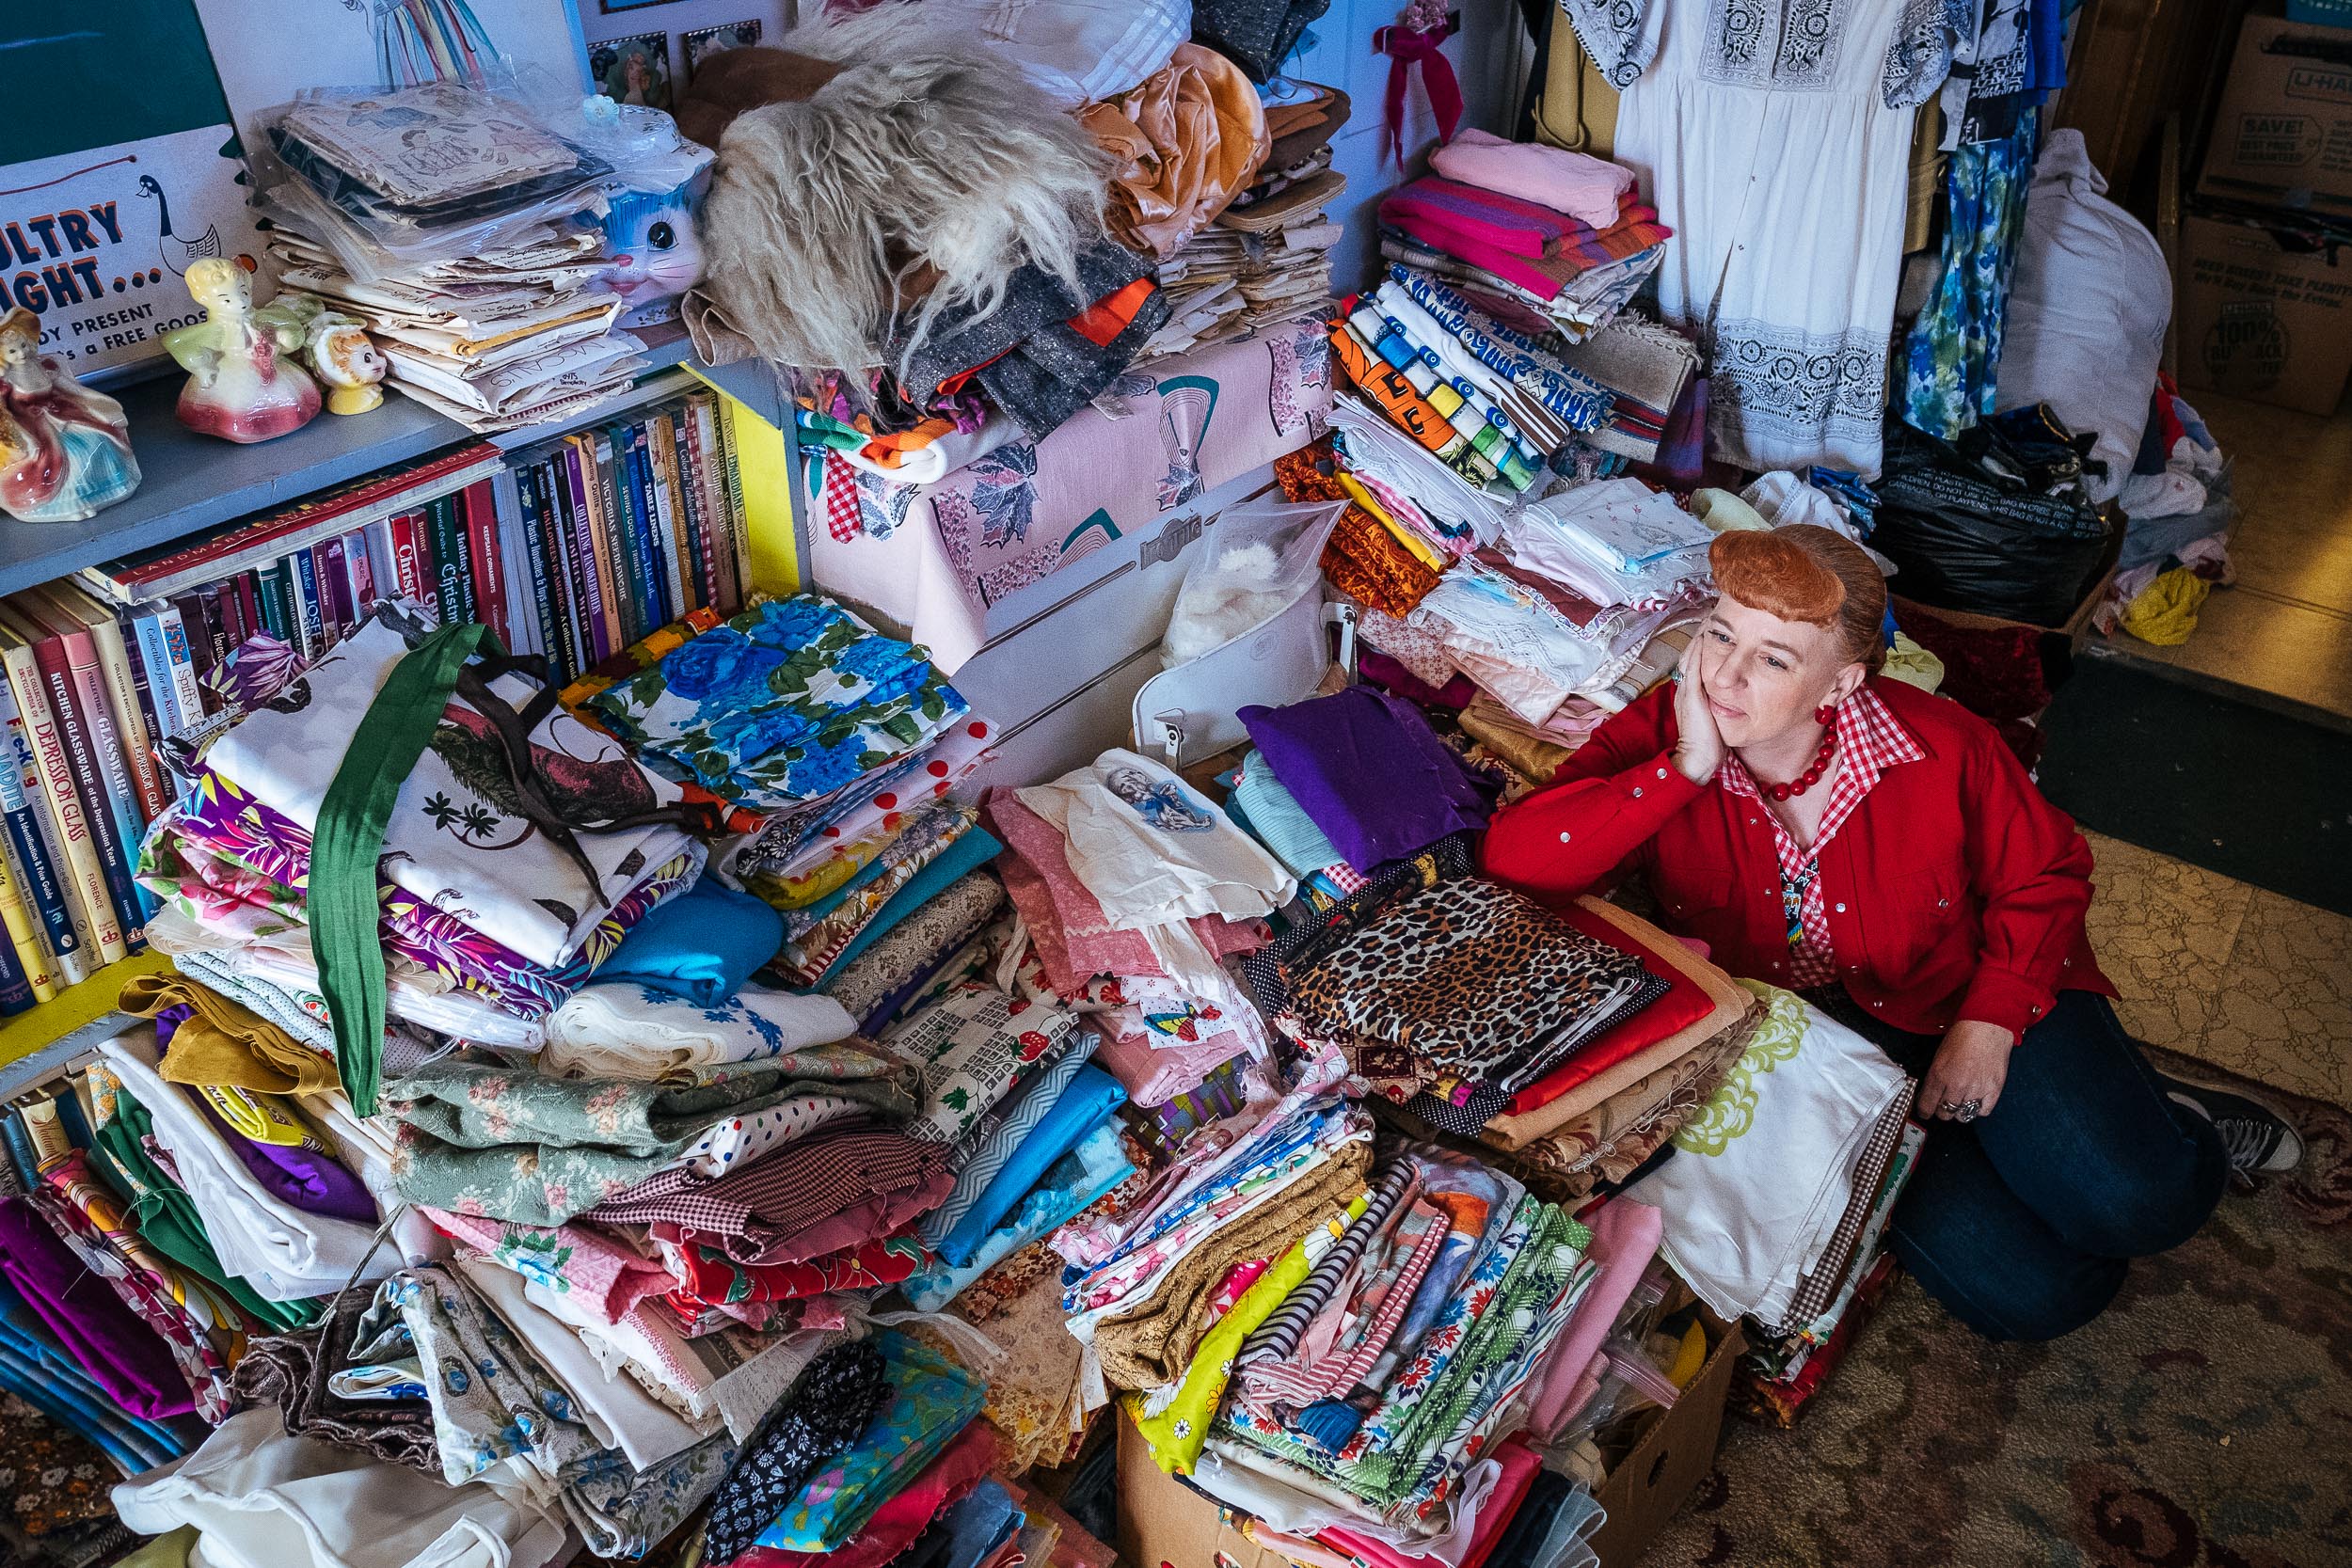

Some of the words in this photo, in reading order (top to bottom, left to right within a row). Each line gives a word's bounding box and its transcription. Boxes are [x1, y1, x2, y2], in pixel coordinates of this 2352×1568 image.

[2294, 73, 2352, 94] U-HA
[2247, 119, 2303, 134] SAVE!
[71, 301, 154, 342] PRESENT
[496, 302, 528, 316] Simplicity
[86, 342, 99, 356] a
[103, 325, 148, 356] FREE
[723, 427, 735, 449] World
[583, 452, 596, 481] ollecting
[640, 450, 650, 481] ELEGANT
[666, 449, 678, 477] Vintage
[676, 448, 691, 481] Colorful
[534, 472, 548, 499] Schneider
[589, 483, 602, 511] Quilts,
[644, 482, 655, 513] TABLE
[671, 478, 683, 508] Souvenir
[703, 456, 723, 496] Antique
[714, 500, 727, 533] Linens
[725, 454, 745, 510] EDWARDIANA
[134, 532, 250, 577] LANDMARK
[262, 496, 344, 531] TOURIST
[357, 448, 480, 499] ATTRACTIONS
[434, 500, 446, 530] Pictorial
[621, 484, 632, 514] SEWING
[657, 485, 671, 519] More
[683, 482, 698, 526] Tablecloths
[415, 520, 430, 552] Brenner
[437, 530, 446, 550] Guide
[480, 525, 493, 557] KEEPSAKE
[524, 518, 540, 545] Plastic
[540, 509, 559, 562] HALLOWEEN
[573, 502, 593, 550] COLLECTING
[594, 512, 606, 550] Investments
[599, 477, 617, 532] VICTORIAN
[608, 534, 628, 601] NEEDLEWORK
[626, 514, 636, 538] TOOLS
[647, 513, 660, 546] LINENS
[675, 510, 688, 546] Tablecloths
[315, 553, 325, 573] Harris
[453, 531, 470, 573] Holiday
[528, 545, 546, 578] Novelties
[566, 531, 582, 583] Fashions
[630, 548, 641, 579] TRINKETS
[297, 557, 315, 590] Whitaker
[484, 557, 498, 594] ORNAMENTS
[580, 552, 603, 615] HANDKERCHIEFS
[600, 558, 612, 588] America's
[319, 578, 330, 606] Whitaker
[460, 574, 475, 609] Plastic
[534, 584, 548, 602] Toys
[605, 588, 615, 614] Heritage
[638, 595, 647, 620] Volume
[279, 581, 304, 639] CZECHOSLOVAKIAN
[303, 597, 325, 640] JOSEF
[142, 626, 166, 672] Collectibles
[559, 621, 576, 660] Collector's
[17, 666, 36, 707] ENCYCLOPEDIA
[30, 706, 39, 719] OF
[24, 664, 34, 677] THE
[29, 676, 45, 714] COLLECTOR'S
[154, 670, 167, 685] for
[159, 685, 171, 699] the
[171, 666, 202, 710] Spiffy
[50, 671, 74, 720] KITCHEN
[110, 662, 128, 699] COLLECTOR'S
[120, 698, 138, 736] ENCYCLOPEDIA
[131, 743, 155, 789] DEPRESSION
[142, 710, 159, 738] Scottie
[161, 697, 182, 733] Kitchen,
[85, 670, 104, 716] COLLECTIBLE
[95, 715, 132, 799] GLASSWARE
[7, 716, 40, 789] Fire-King
[64, 719, 94, 785] GLASSWARE
[34, 720, 74, 805] DEPRESSION
[59, 801, 86, 843] GLASS
[87, 786, 96, 797] of
[33, 794, 43, 806] An
[89, 796, 100, 807] the
[19, 820, 40, 861] Identification
[37, 804, 57, 845] Information
[92, 807, 111, 845] Depression
[49, 844, 60, 859] and
[104, 844, 119, 866] Years
[35, 865, 47, 880] Price
[40, 879, 54, 900] Guide
[86, 872, 103, 911] FLORENCE
